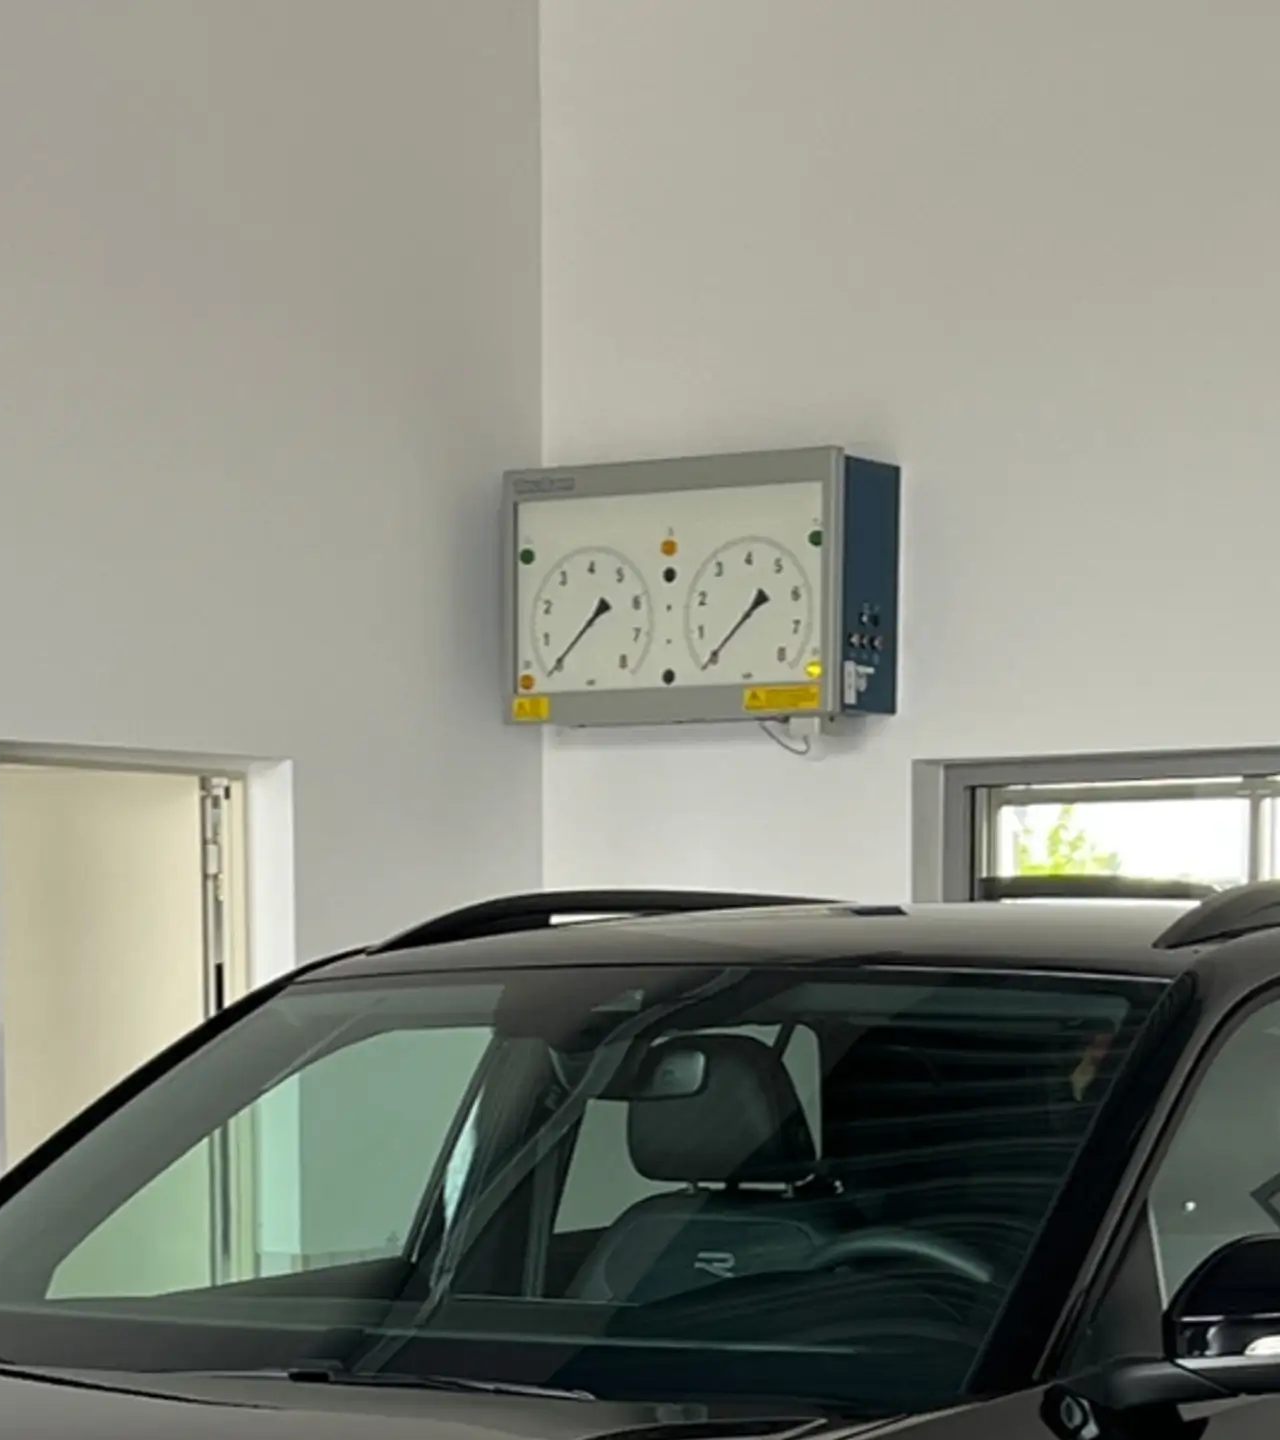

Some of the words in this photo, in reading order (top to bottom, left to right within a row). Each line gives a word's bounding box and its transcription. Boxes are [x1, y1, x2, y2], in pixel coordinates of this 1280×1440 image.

[744, 551, 754, 566] 4
[774, 557, 784, 574] 5
[587, 560, 597, 575] 4
[616, 566, 625, 583] 5
[714, 561, 724, 577] 3
[558, 570, 568, 587] 3
[698, 590, 708, 606] 2
[791, 585, 801, 602] 6
[543, 600, 553, 615] 2
[632, 595, 642, 611] 6
[632, 626, 642, 643] 7
[697, 624, 705, 640] 1
[792, 619, 801, 635] 7
[542, 631, 551, 647] 1
